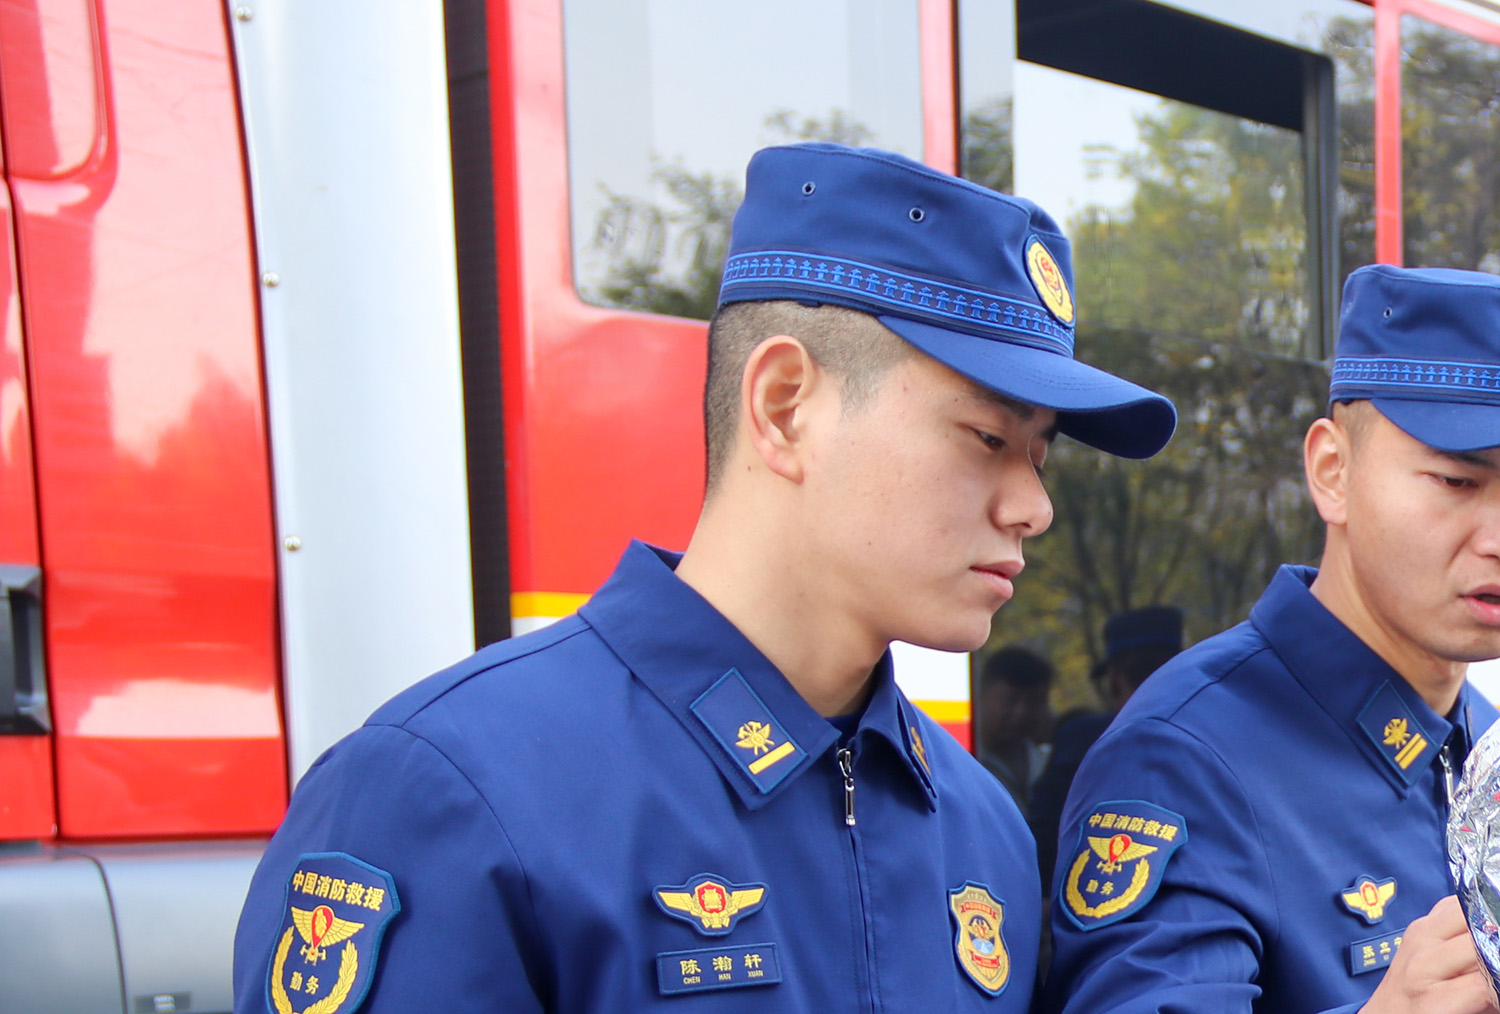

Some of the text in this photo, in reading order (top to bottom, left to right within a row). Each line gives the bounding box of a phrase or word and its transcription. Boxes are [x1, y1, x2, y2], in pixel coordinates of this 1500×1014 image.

[1088, 813, 1178, 842] 中国消防救援
[292, 870, 385, 911] 中国消防救援
[289, 971, 319, 995] 勤务
